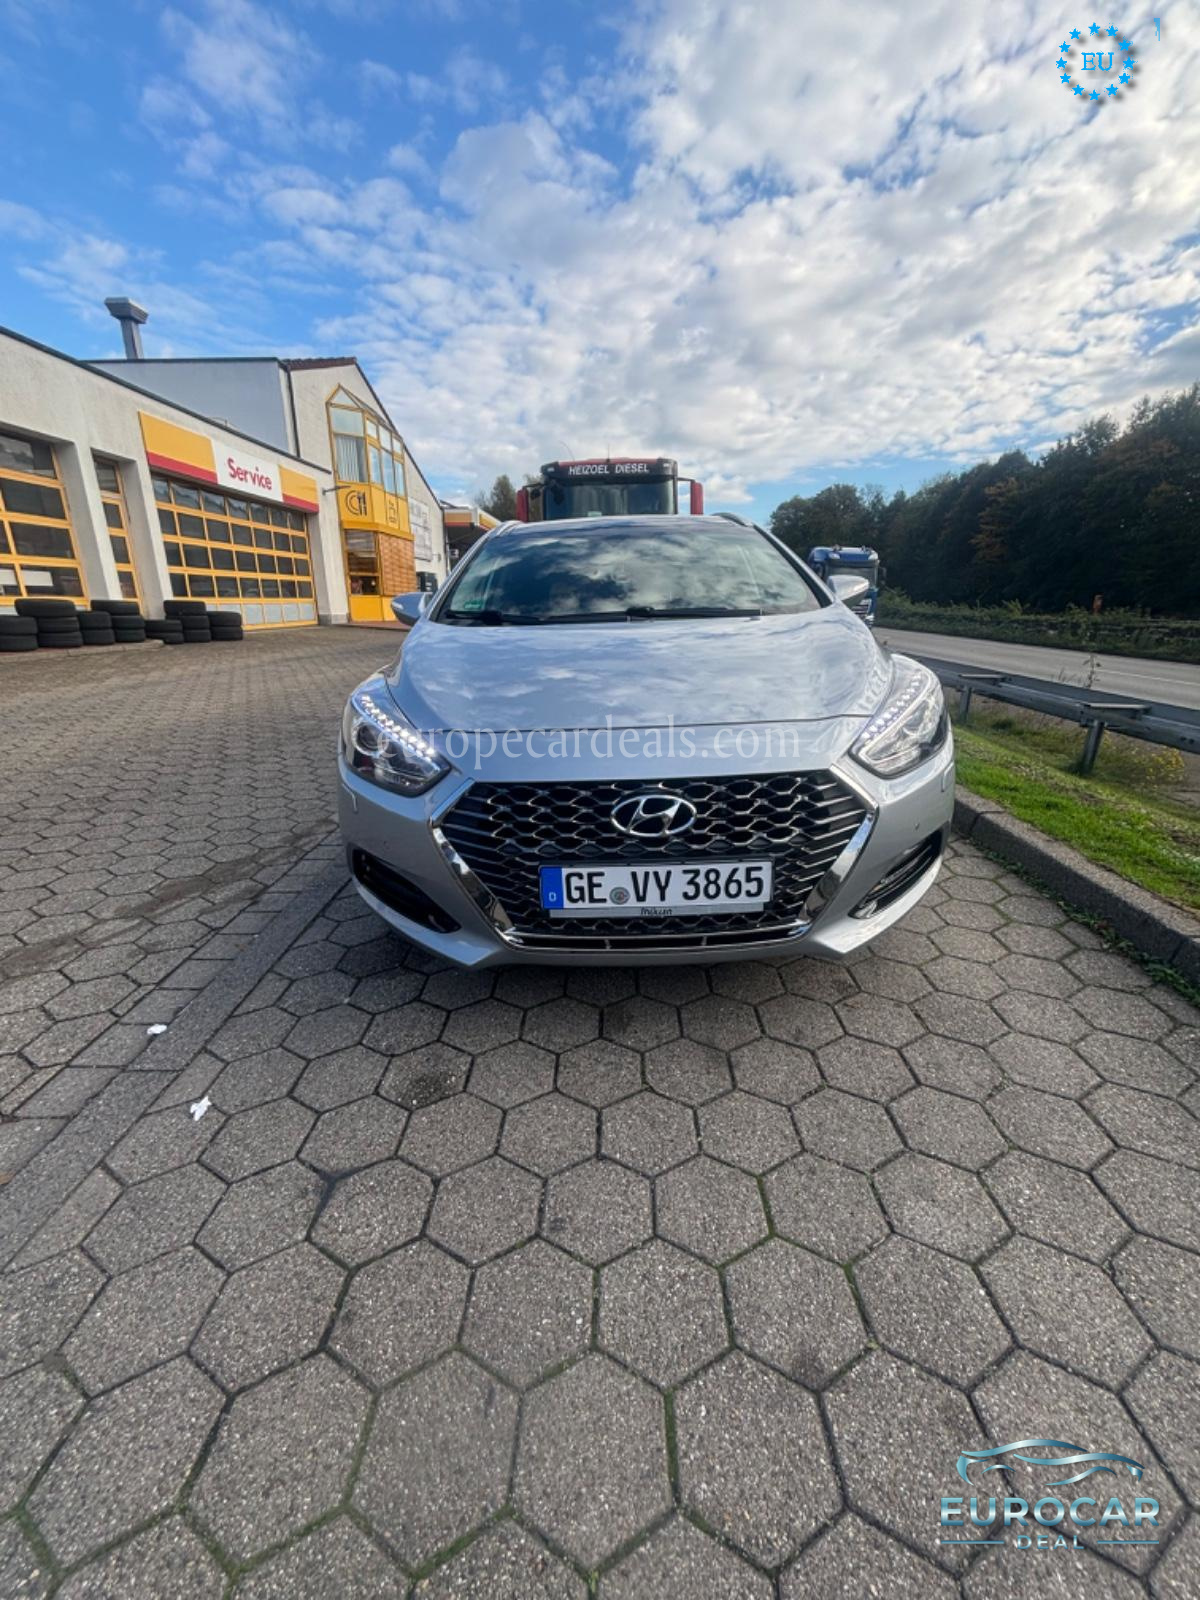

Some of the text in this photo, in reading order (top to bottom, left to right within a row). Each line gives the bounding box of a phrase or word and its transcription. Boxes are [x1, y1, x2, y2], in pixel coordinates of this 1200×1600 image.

[227, 457, 273, 490] Service
[568, 463, 650, 475] HEIZOEL DIESEL
[565, 866, 764, 904] GE VY 3865
